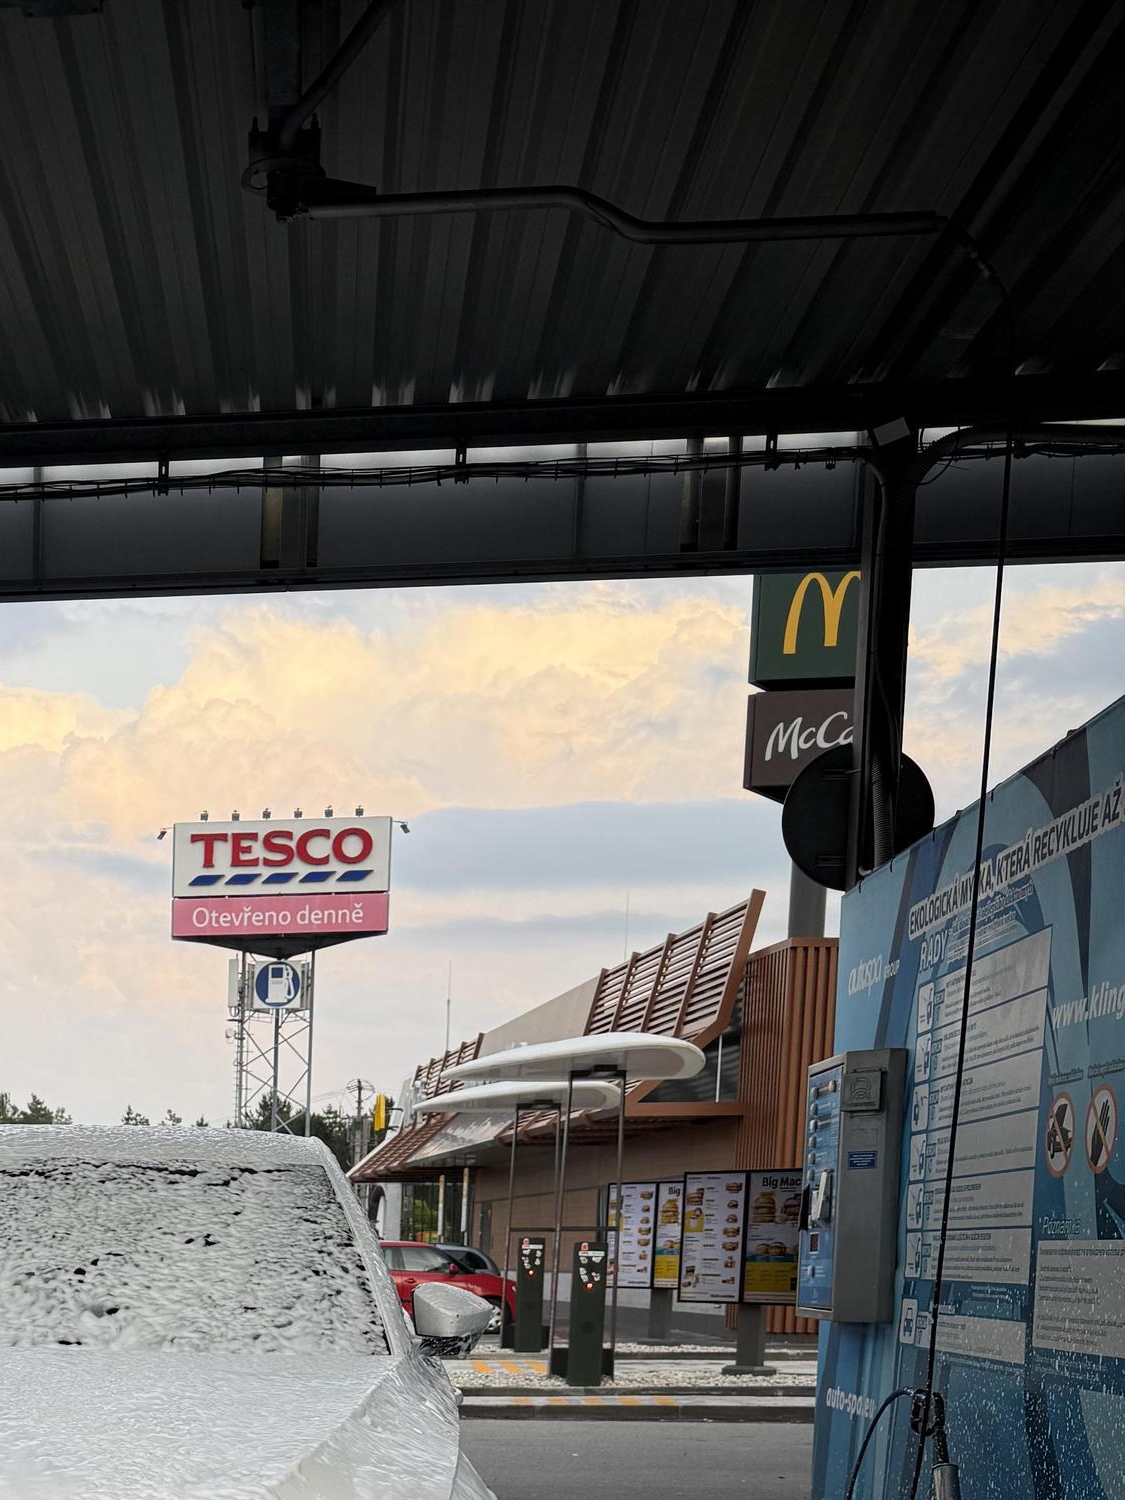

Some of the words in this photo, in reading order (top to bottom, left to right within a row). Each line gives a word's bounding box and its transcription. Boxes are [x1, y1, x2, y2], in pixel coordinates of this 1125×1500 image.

[190, 827, 374, 868] TESCO
[909, 878, 958, 936] EKOLOGICKÁ
[960, 864, 993, 906] MYKA,
[997, 837, 1030, 886] KTERÁ
[1033, 801, 1098, 865] RECYKLUJE
[1101, 782, 1121, 832] AŽ
[192, 904, 291, 928] Otevřeno
[296, 902, 364, 925] denně
[919, 929, 949, 970] RADY
[668, 1186, 681, 1197] Big
[763, 1176, 778, 1190] Big
[779, 1177, 802, 1187] Mac
[826, 1385, 875, 1421] auto-spa.eu
